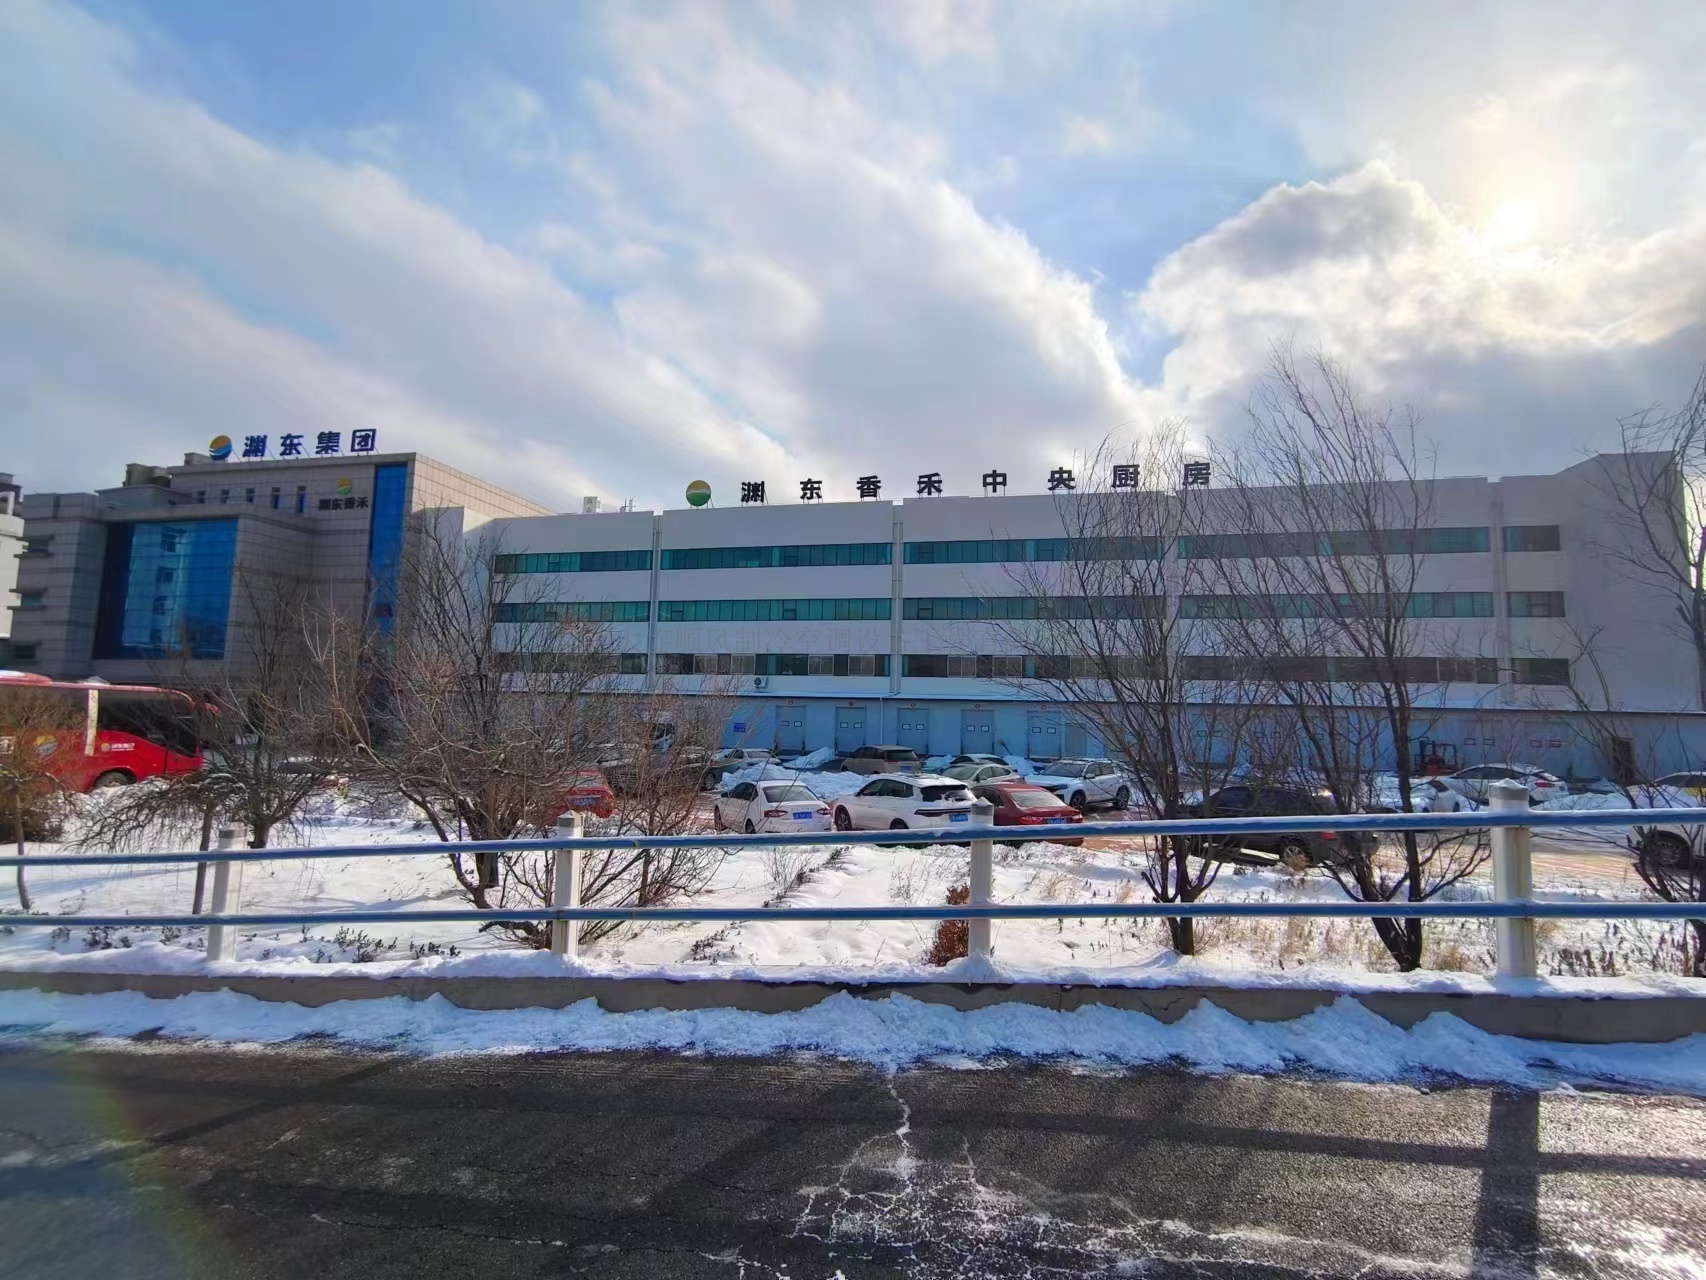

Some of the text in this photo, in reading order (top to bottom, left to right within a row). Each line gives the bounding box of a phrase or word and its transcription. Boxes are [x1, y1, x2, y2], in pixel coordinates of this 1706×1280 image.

[242, 428, 377, 458] 渊东集团
[740, 461, 1212, 503] 渊东香禾中央厨房
